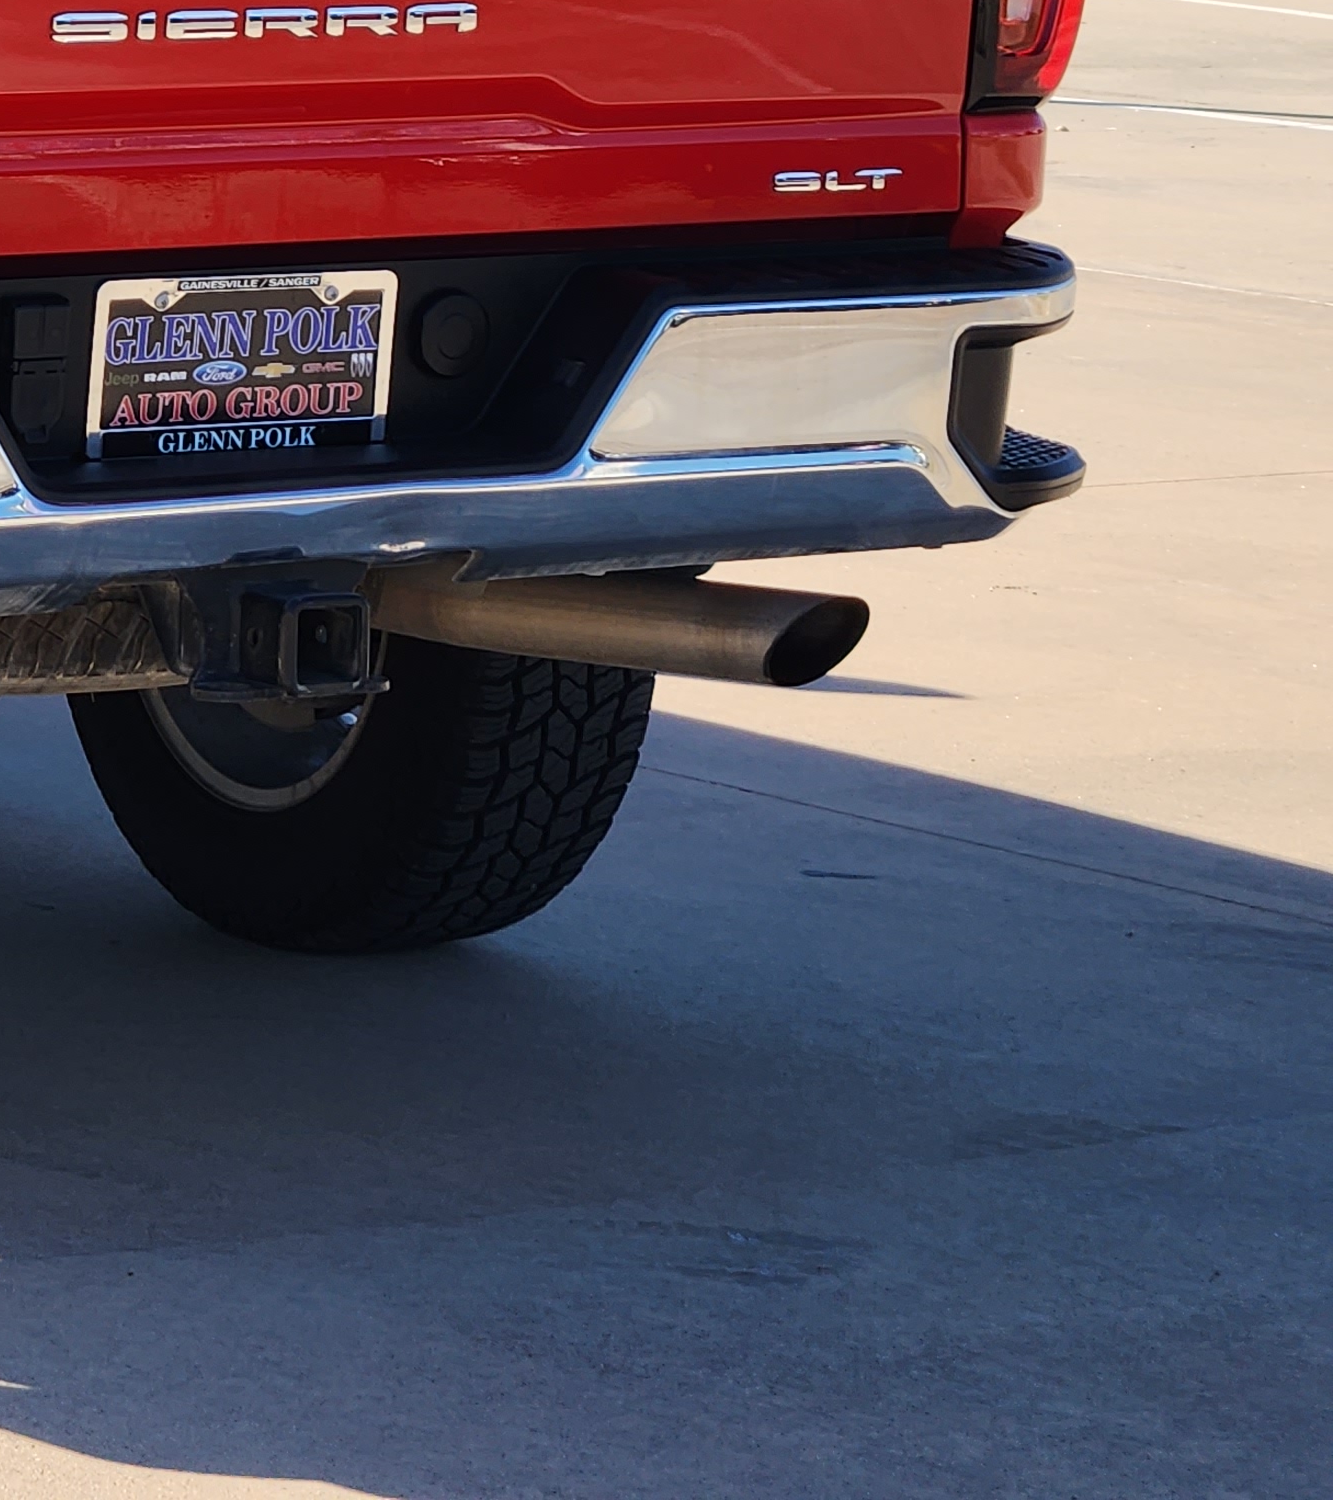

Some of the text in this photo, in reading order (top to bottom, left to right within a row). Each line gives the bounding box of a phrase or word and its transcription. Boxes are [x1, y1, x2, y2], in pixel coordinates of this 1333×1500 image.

[51, 2, 478, 44] SIERRA
[773, 168, 903, 192] SLT
[104, 304, 381, 366] GLENN POLK
[144, 371, 187, 383] RAM
[109, 381, 364, 427] AUTO GROUP
[158, 425, 317, 454] GLENN POLK
